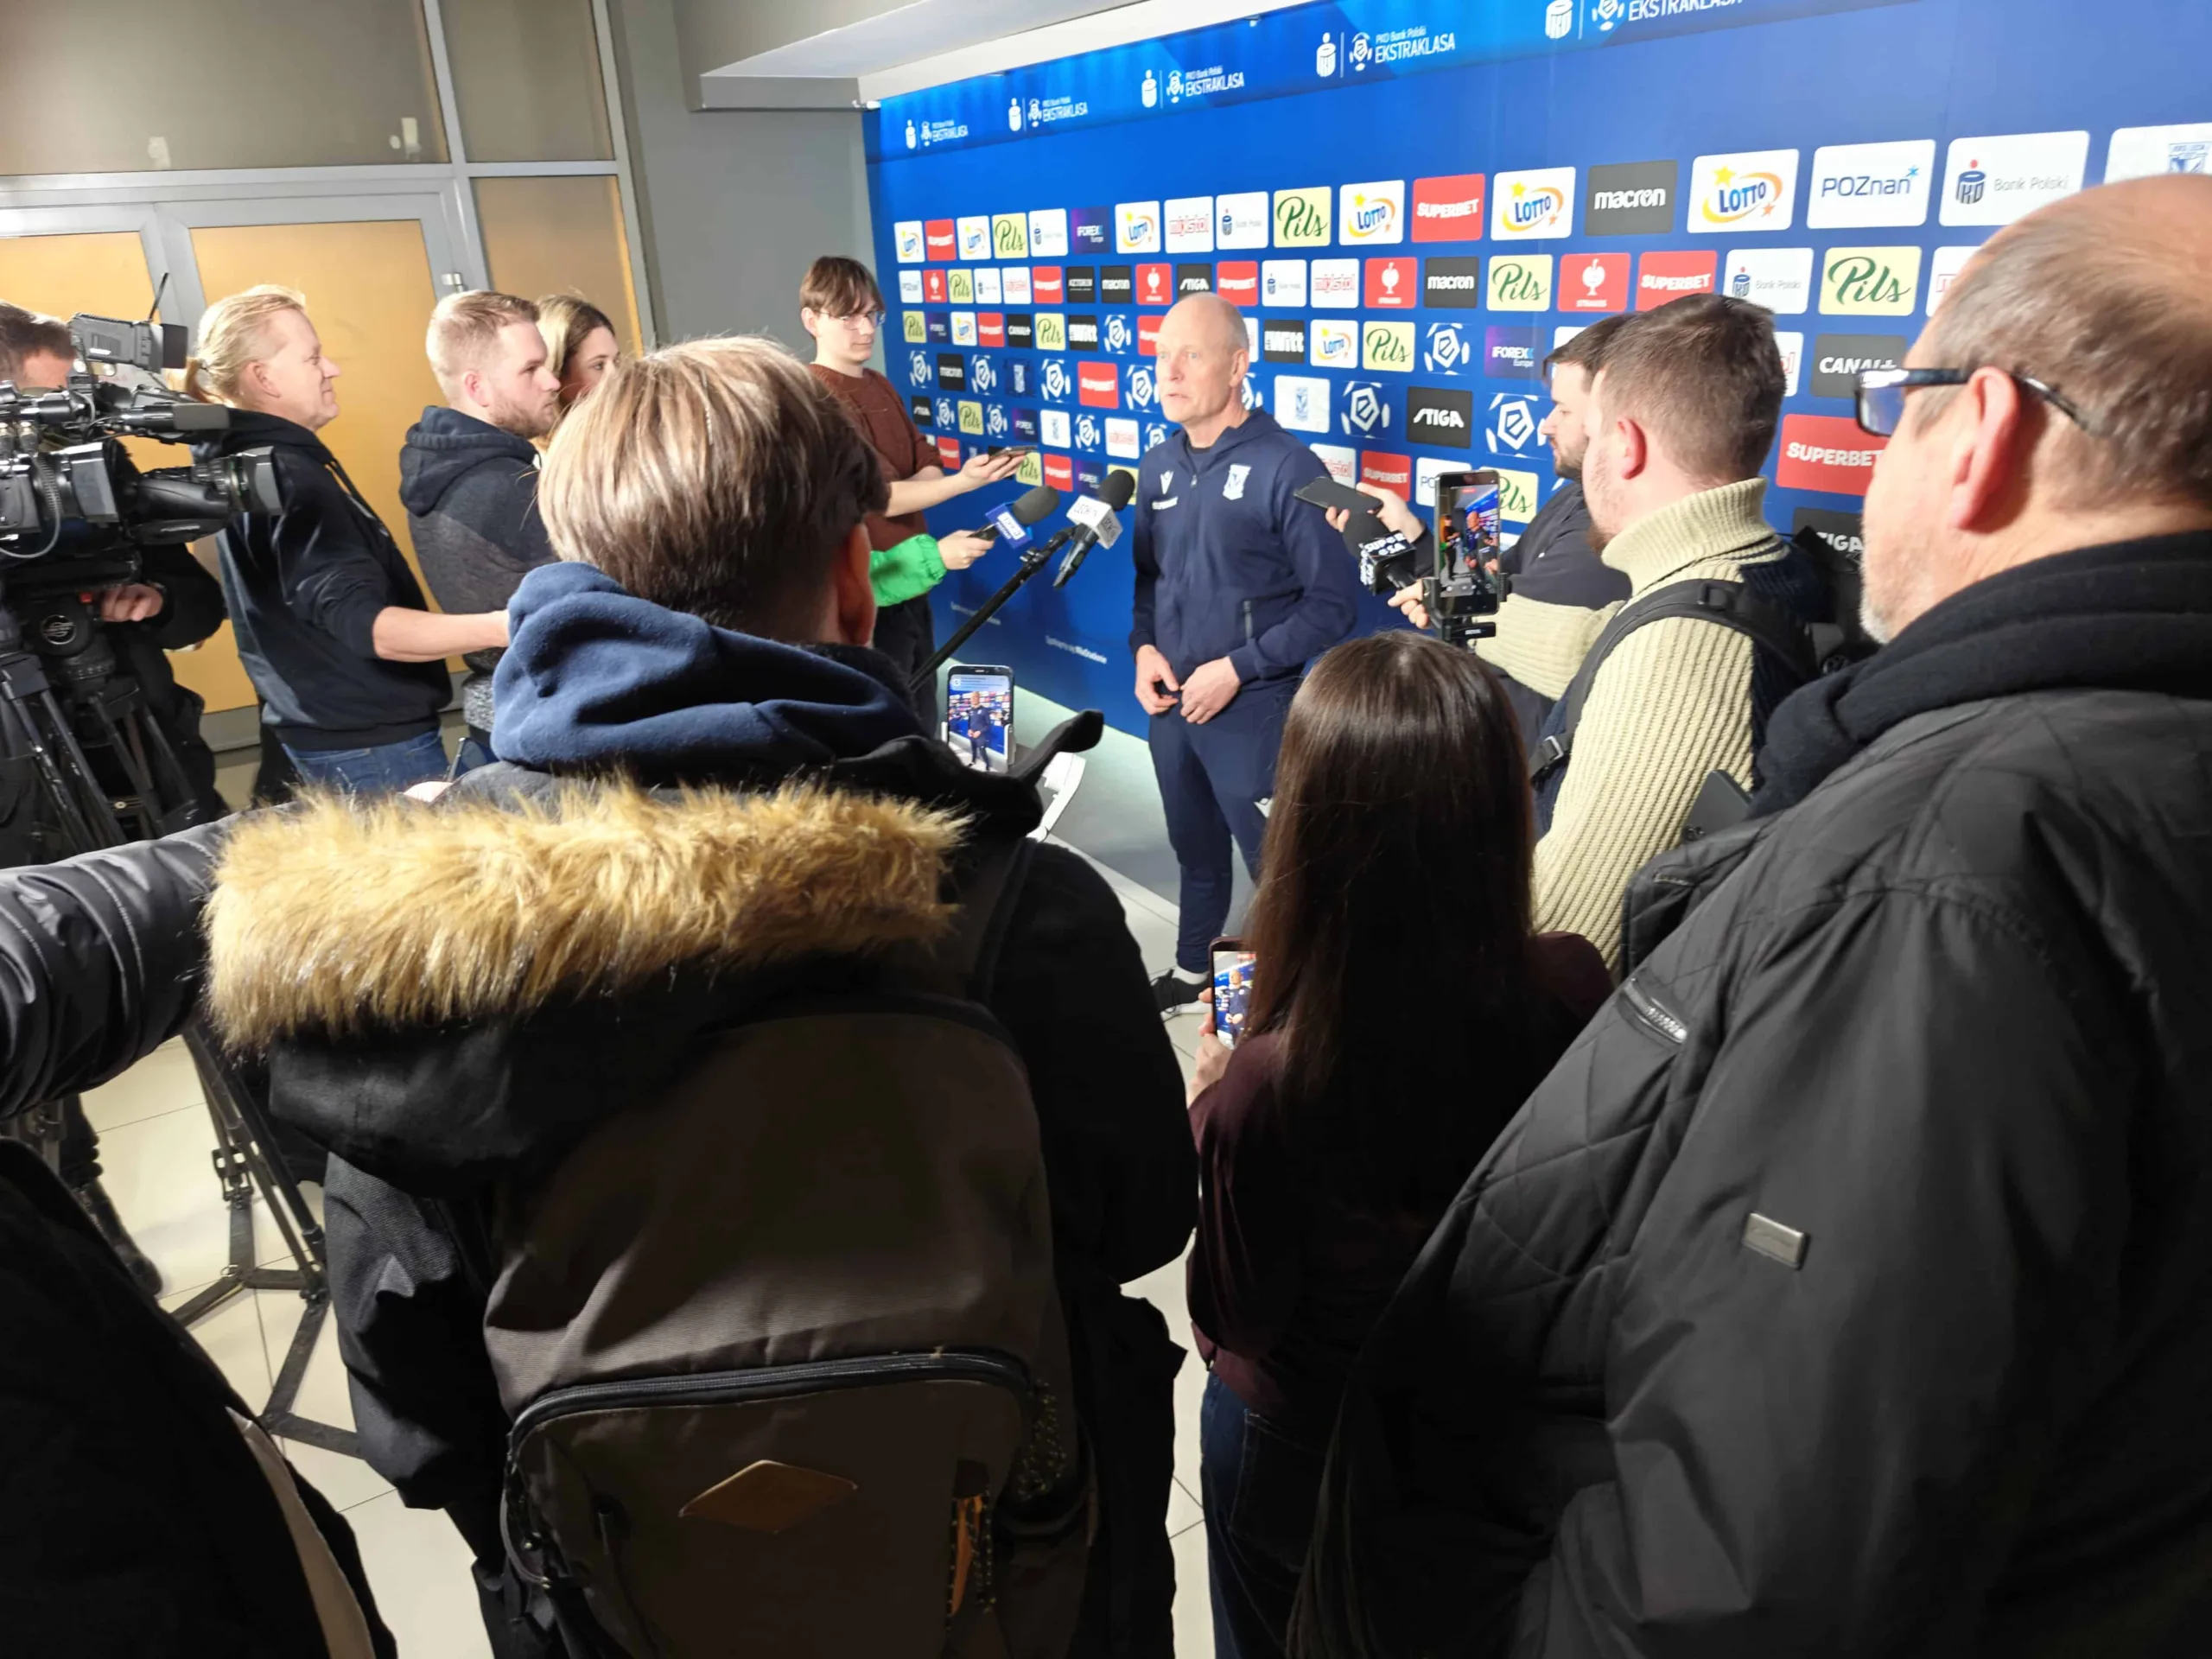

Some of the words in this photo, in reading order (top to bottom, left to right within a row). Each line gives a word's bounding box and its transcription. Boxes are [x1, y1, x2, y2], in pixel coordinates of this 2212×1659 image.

[1375, 32, 1455, 64] EKSTRAKLASA
[1185, 72, 1244, 97] EKSTRAKLASA
[1994, 178, 2025, 191] Bank
[2030, 174, 2069, 190] Polski
[1416, 199, 1479, 219] SUPERBET
[1515, 195, 1552, 223] LOTTO
[1594, 188, 1666, 210] macron
[1719, 181, 1766, 213] LOTTO
[1277, 196, 1328, 240] Pils
[1357, 206, 1386, 230] LOTTO
[995, 219, 1026, 253] Pils
[1427, 276, 1474, 290] macron
[1492, 263, 1547, 302] Pils
[1641, 273, 1711, 290] SUPERBET
[1827, 257, 1911, 304] Pils
[1037, 318, 1064, 344] Pils
[1366, 328, 1412, 363] Pils
[1413, 407, 1465, 429] STIGA
